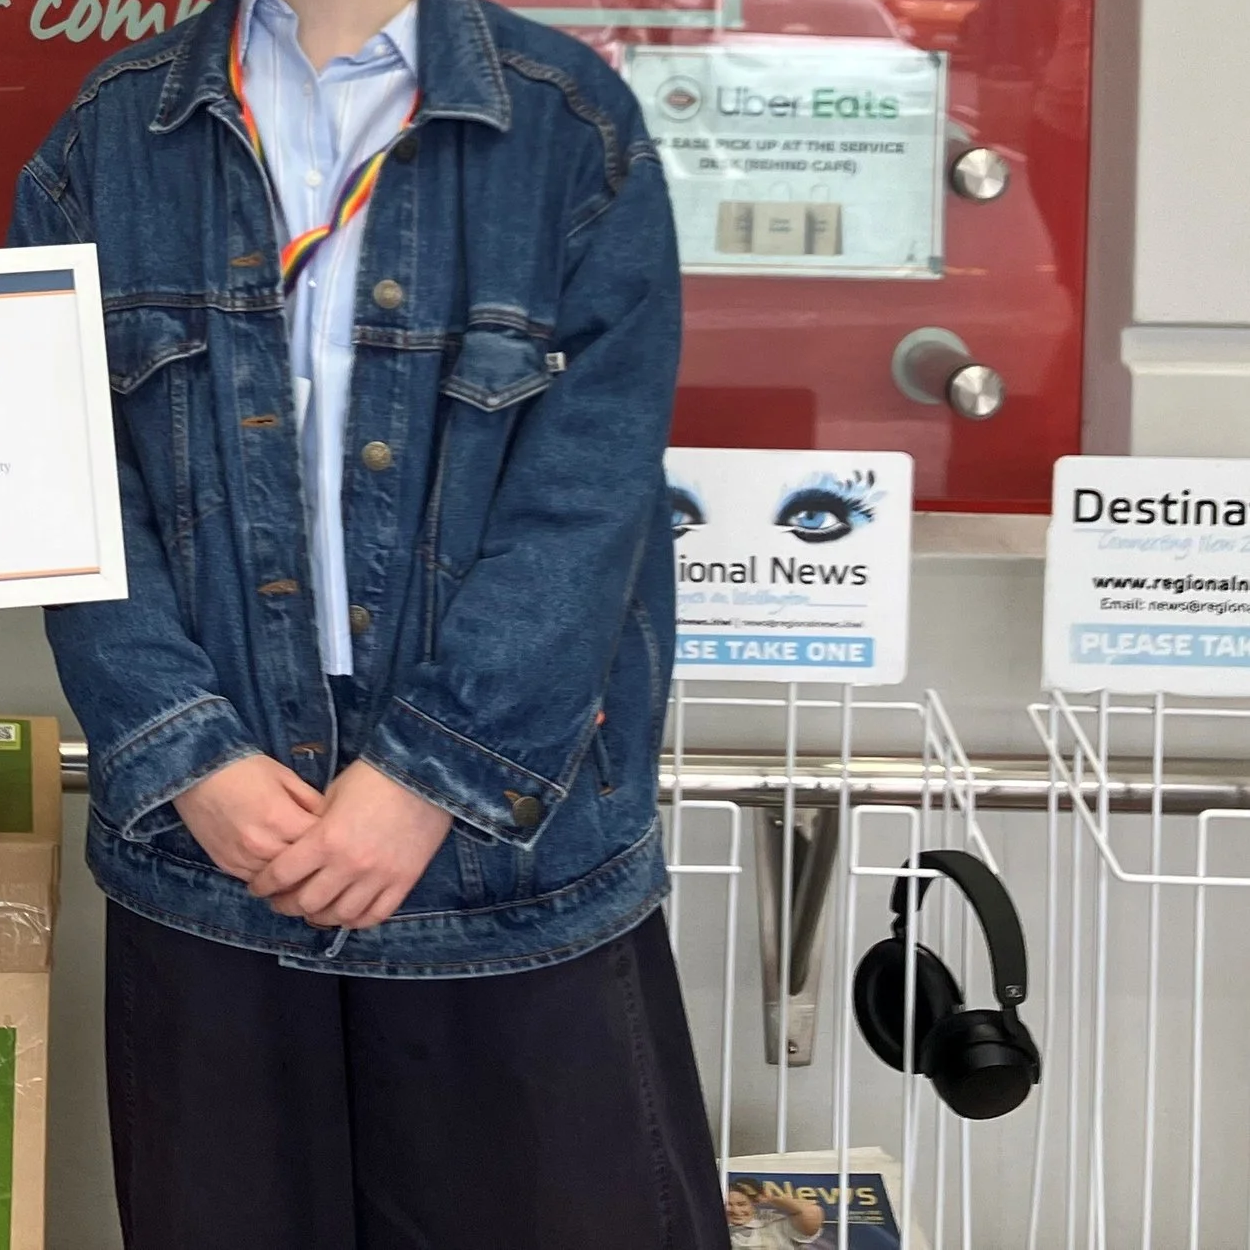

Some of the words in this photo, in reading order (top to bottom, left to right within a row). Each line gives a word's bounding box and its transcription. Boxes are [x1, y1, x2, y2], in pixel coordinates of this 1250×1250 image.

[717, 87, 799, 117] Uber
[812, 87, 900, 119] Eats
[1073, 488, 1250, 527] Destina
[770, 556, 868, 586] News
[725, 640, 800, 661] TAKE
[805, 641, 866, 662] ONE
[1080, 631, 1194, 657] PLEASE
[762, 1180, 879, 1207] News
